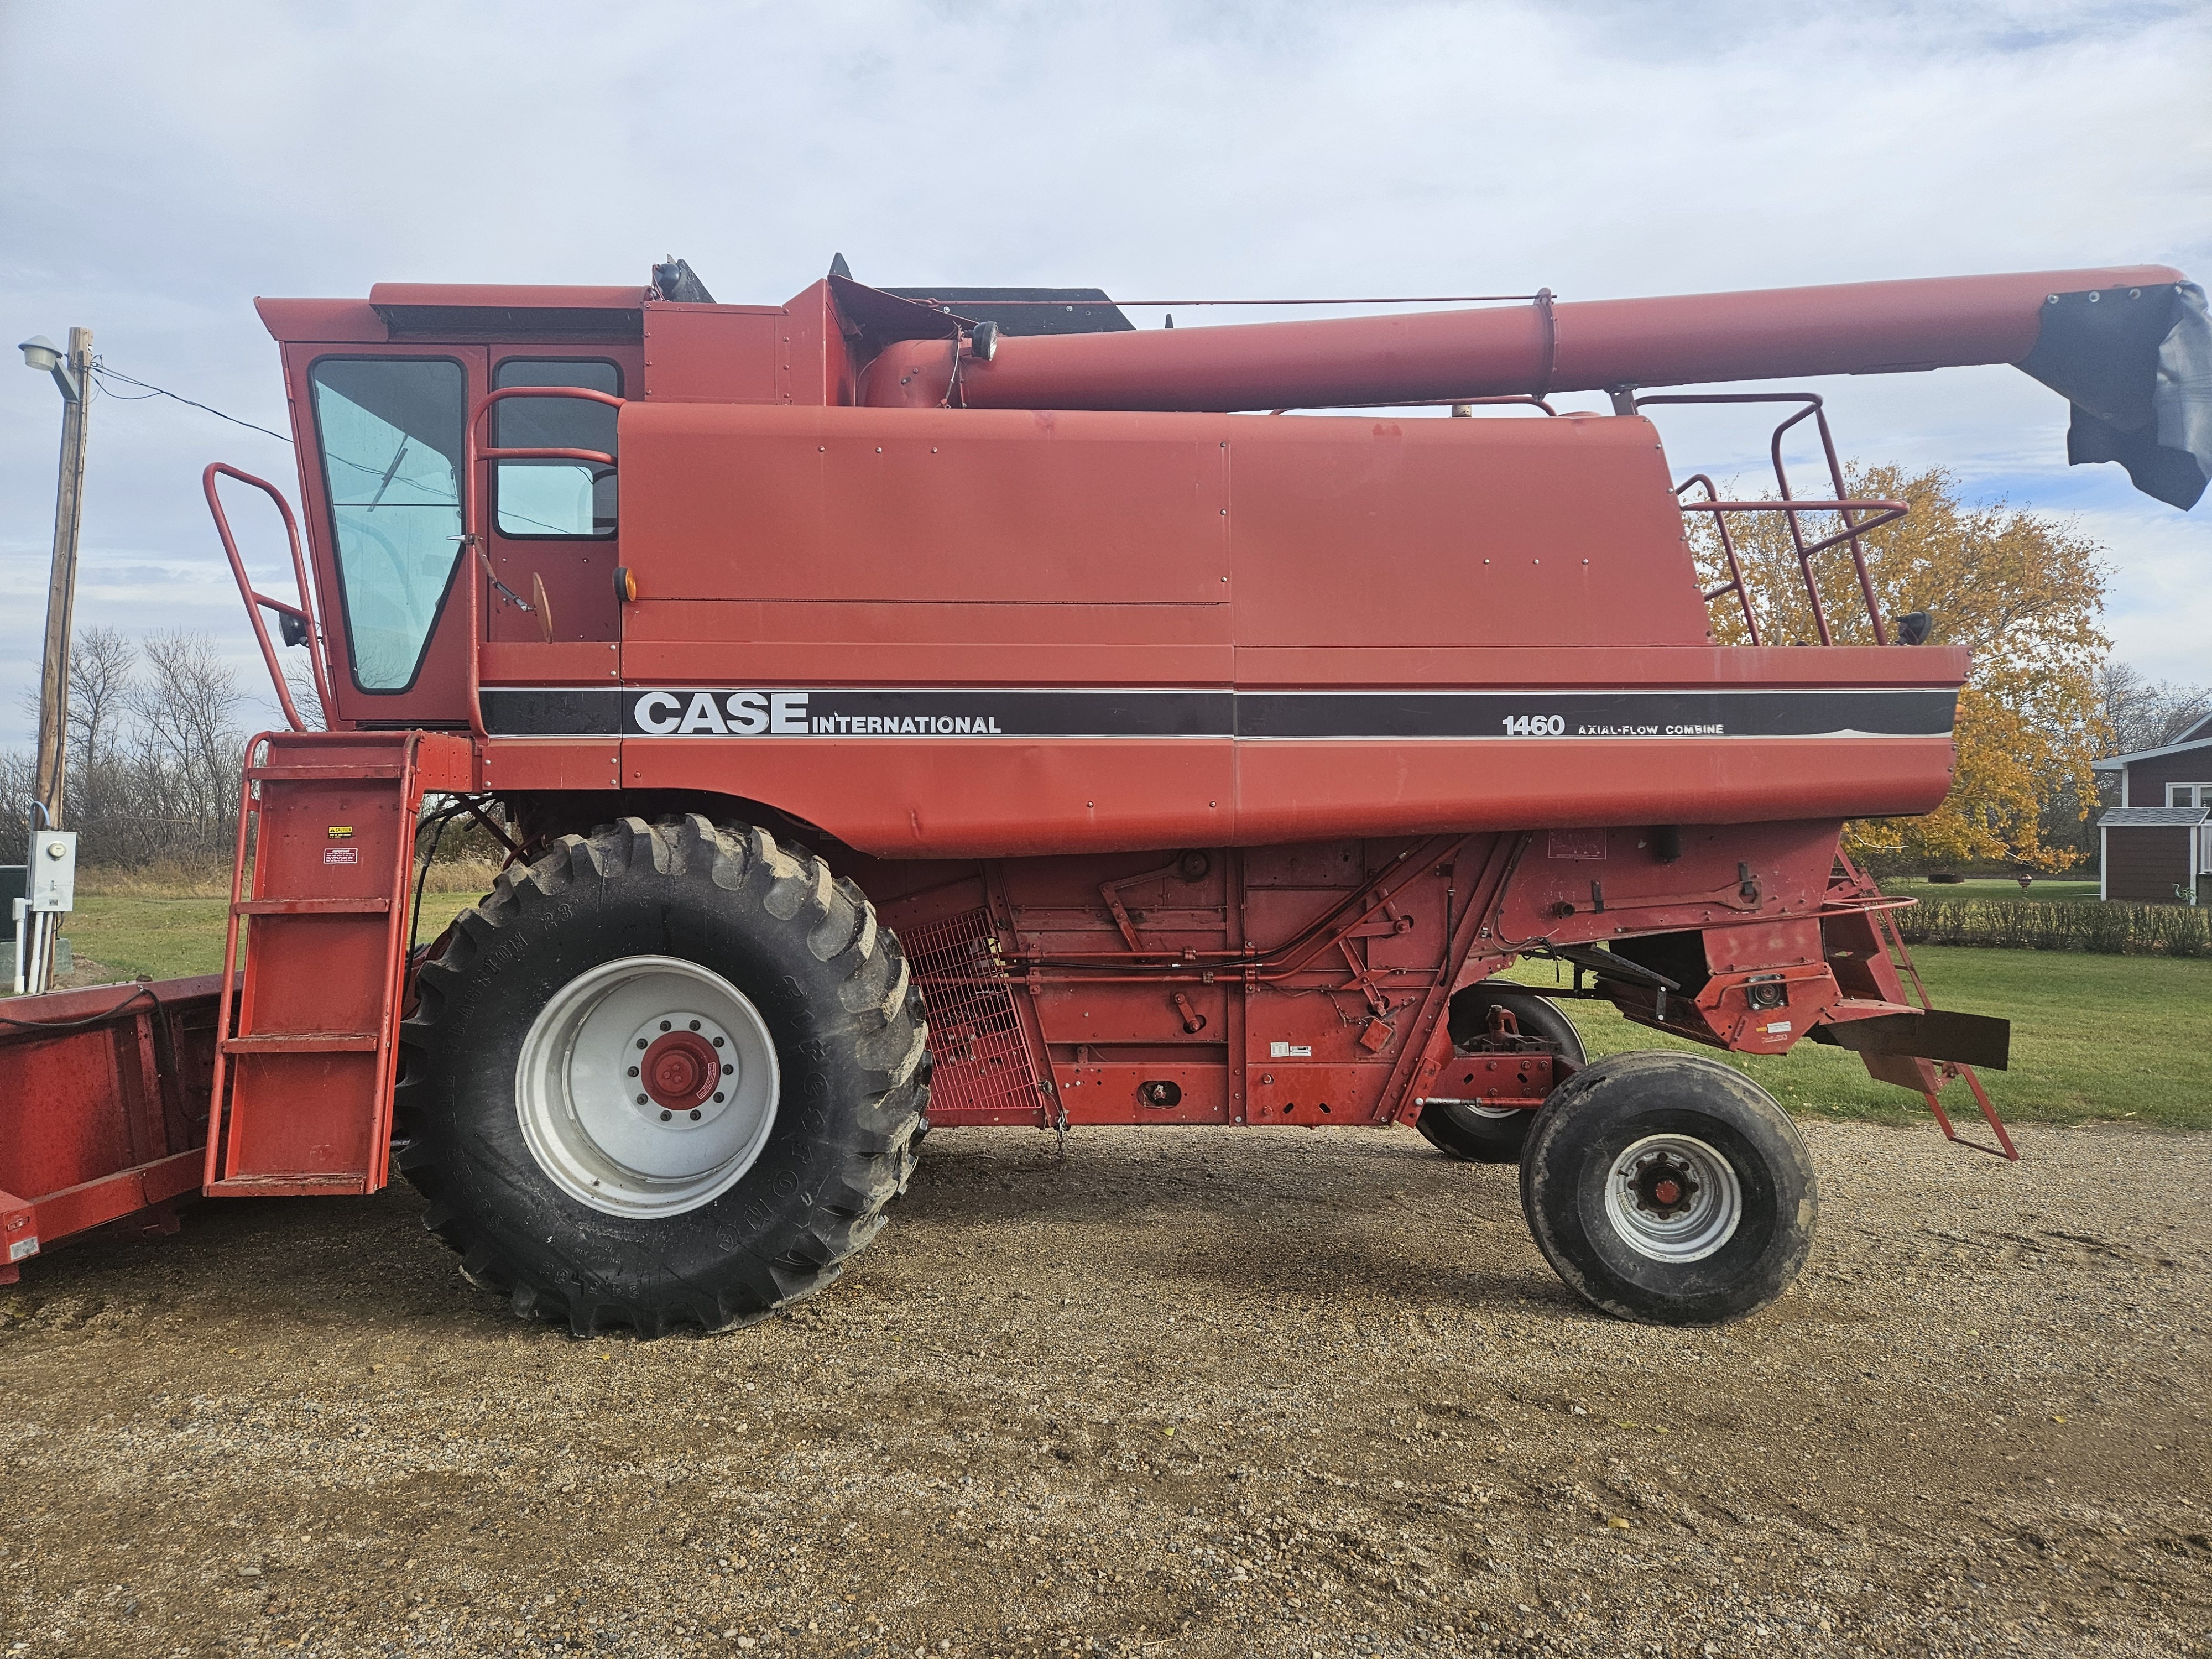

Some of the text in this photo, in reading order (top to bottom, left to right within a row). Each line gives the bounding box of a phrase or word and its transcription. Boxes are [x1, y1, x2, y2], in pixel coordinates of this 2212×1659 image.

[634, 692, 1001, 734] CASE INTERNATIONAL
[1502, 714, 1724, 735] 1460 AXIAL-FLOW COMBINE
